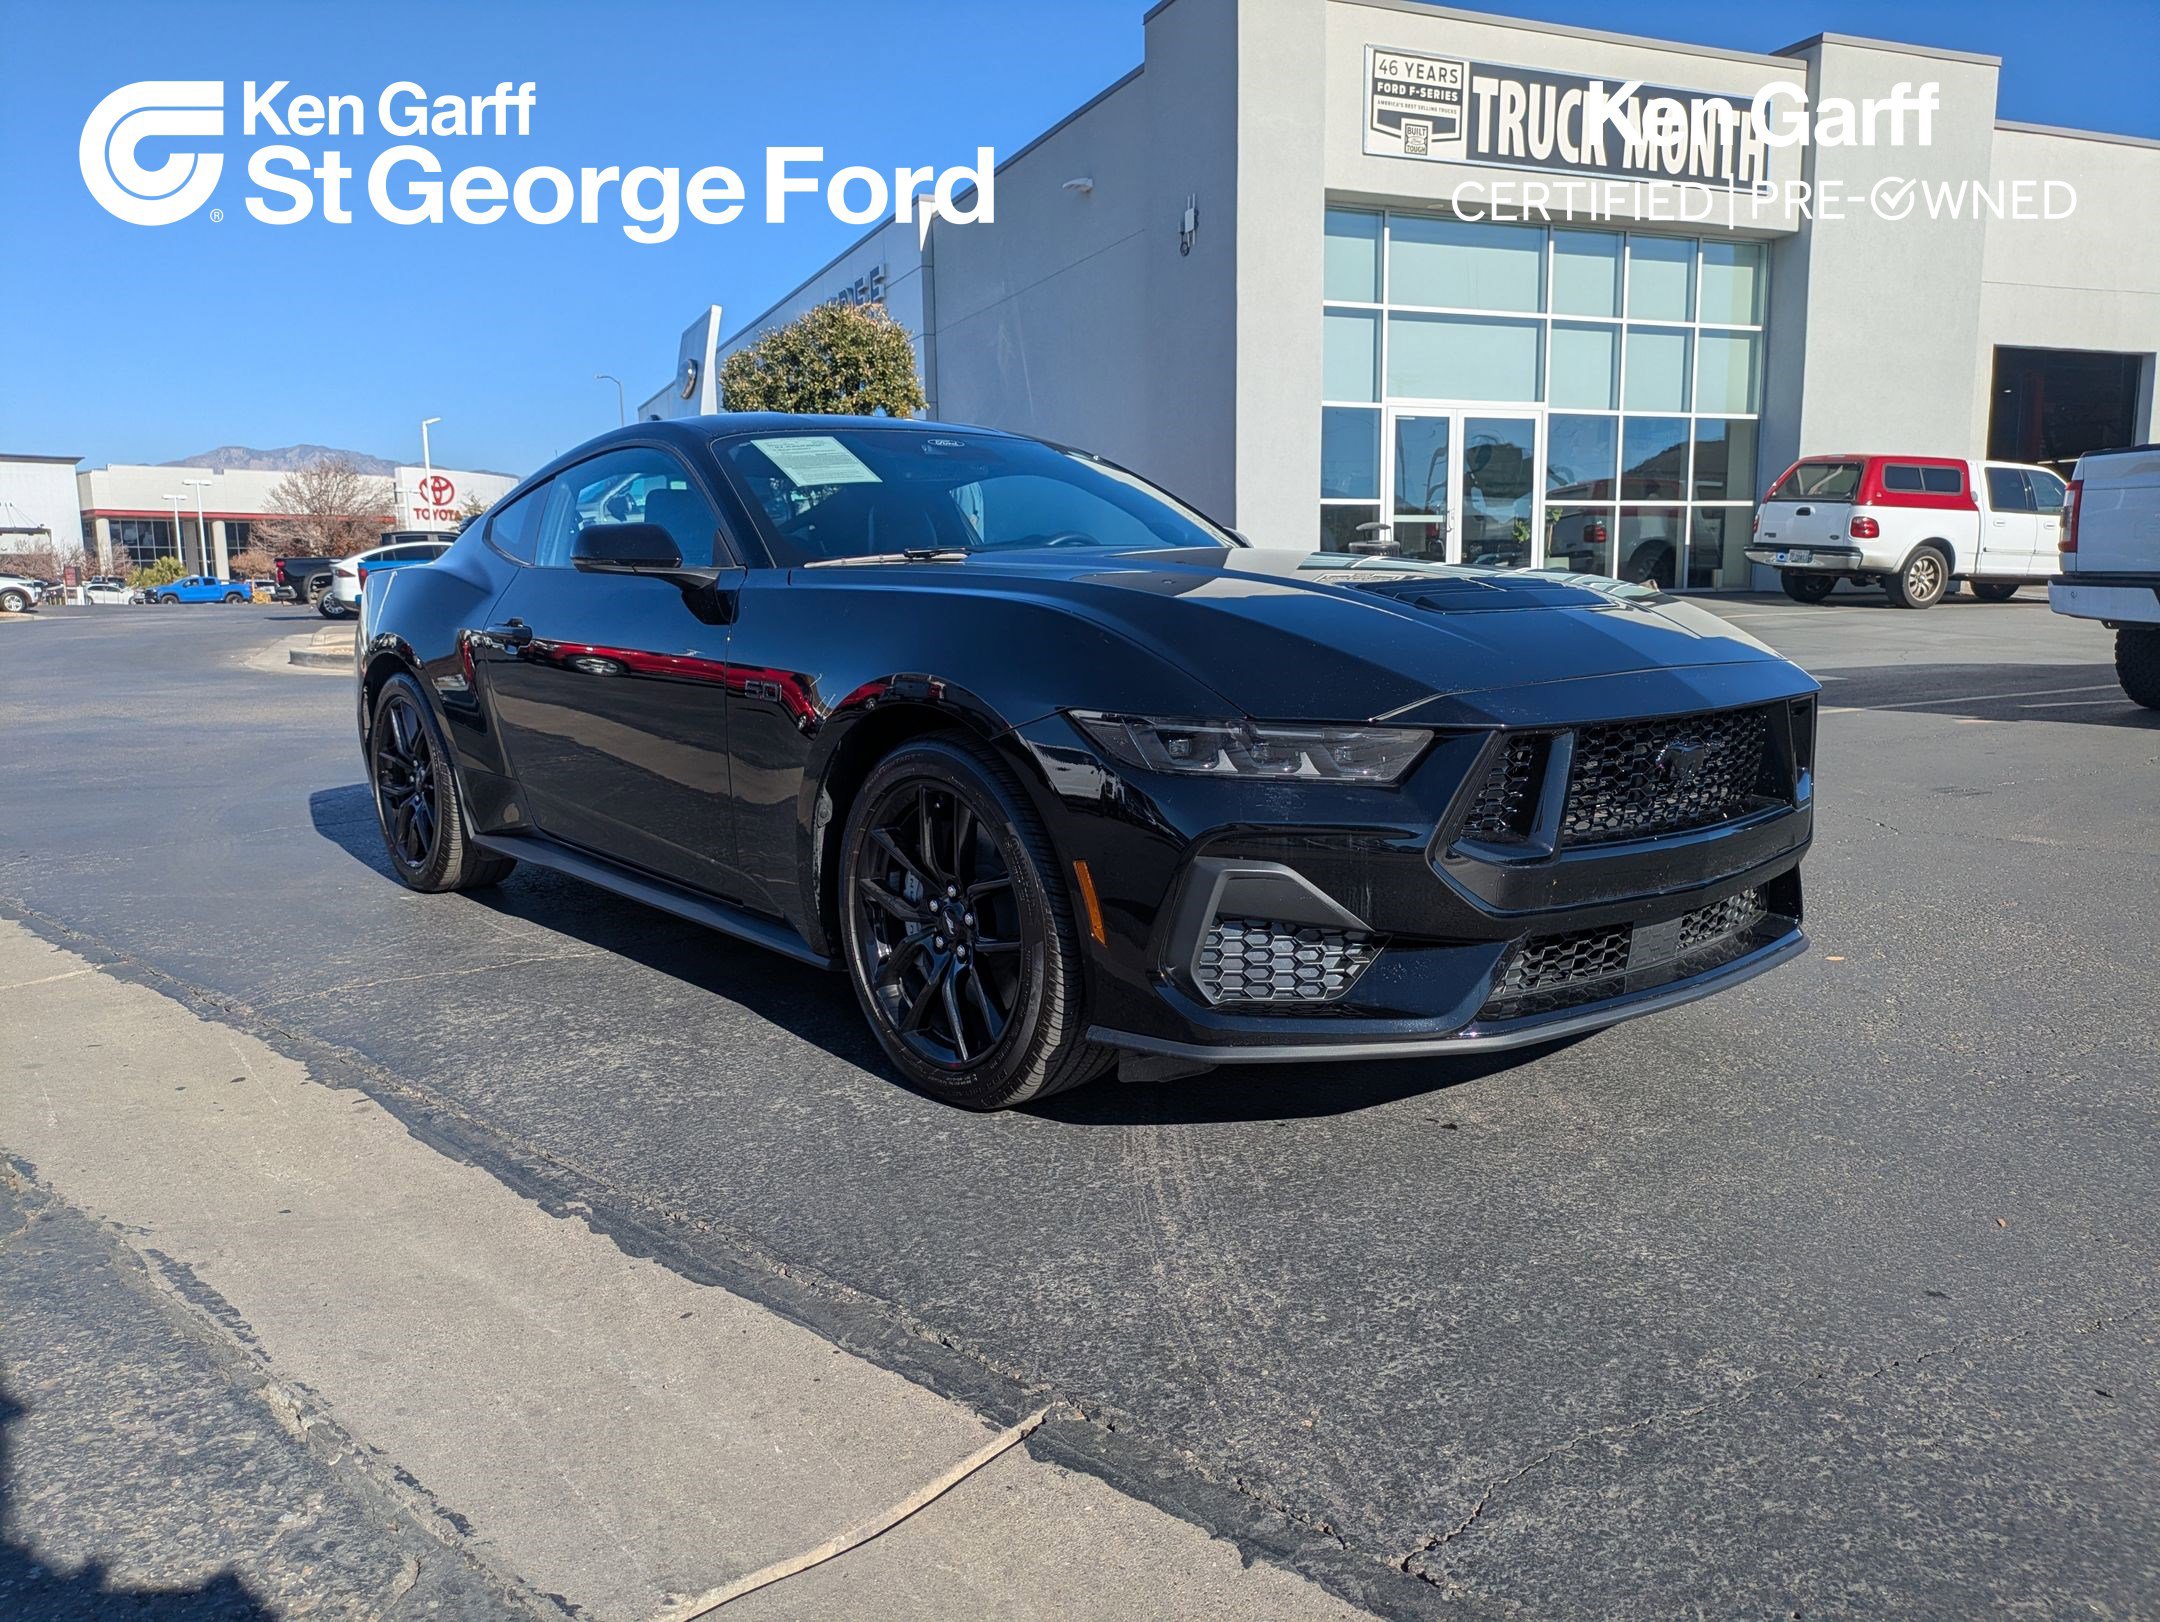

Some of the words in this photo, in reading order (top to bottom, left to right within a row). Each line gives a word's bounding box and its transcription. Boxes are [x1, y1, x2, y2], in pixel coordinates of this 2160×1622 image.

[1379, 59, 1398, 76] 46
[1405, 62, 1458, 84] YEARS
[1377, 82, 1406, 95] FORD
[1409, 86, 1458, 101] F-SERIES
[1472, 76, 1607, 166] TRUCK
[1407, 126, 1426, 136] BUILT
[1406, 145, 1426, 153] TOUGH
